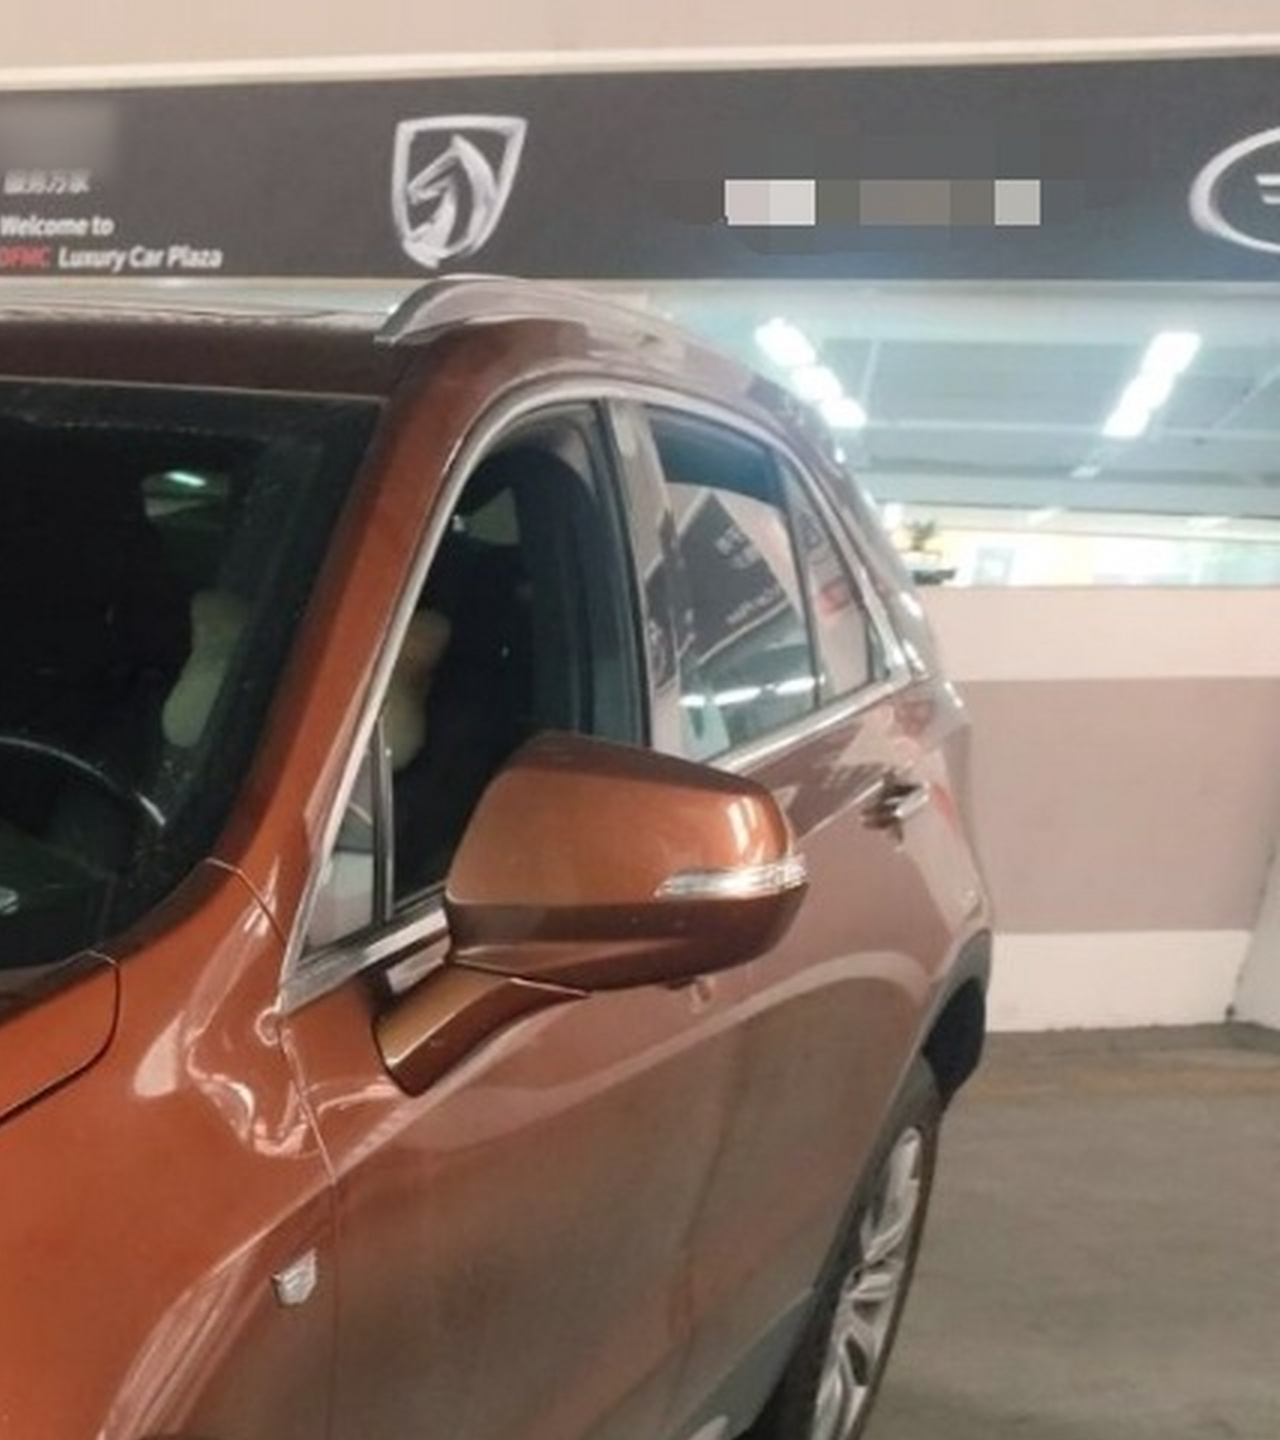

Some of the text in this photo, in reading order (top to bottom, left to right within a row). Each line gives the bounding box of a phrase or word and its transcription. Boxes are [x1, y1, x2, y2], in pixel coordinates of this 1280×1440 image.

[91, 215, 116, 237] to
[57, 246, 127, 273] Luxury
[127, 246, 165, 268] Car
[165, 245, 224, 269] Plaza
